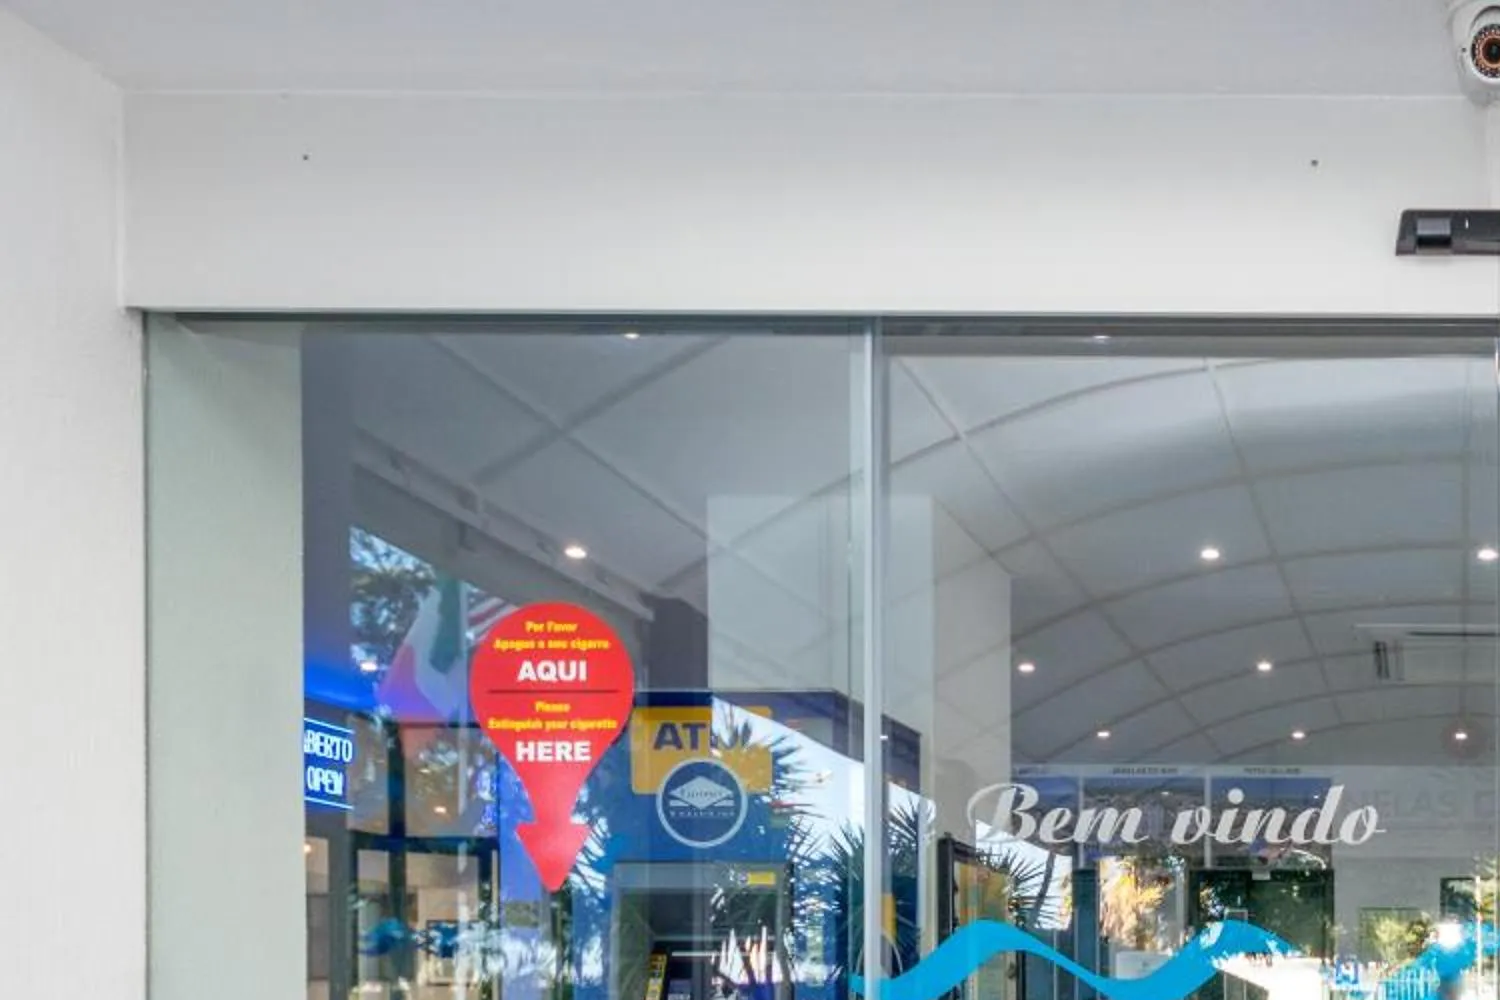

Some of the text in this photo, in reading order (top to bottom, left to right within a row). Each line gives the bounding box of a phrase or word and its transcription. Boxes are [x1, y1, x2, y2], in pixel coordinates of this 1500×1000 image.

[517, 659, 588, 682] AQUI
[515, 740, 592, 762] HERE
[307, 766, 343, 796] OPEN
[967, 783, 1387, 845] Bem vindo
